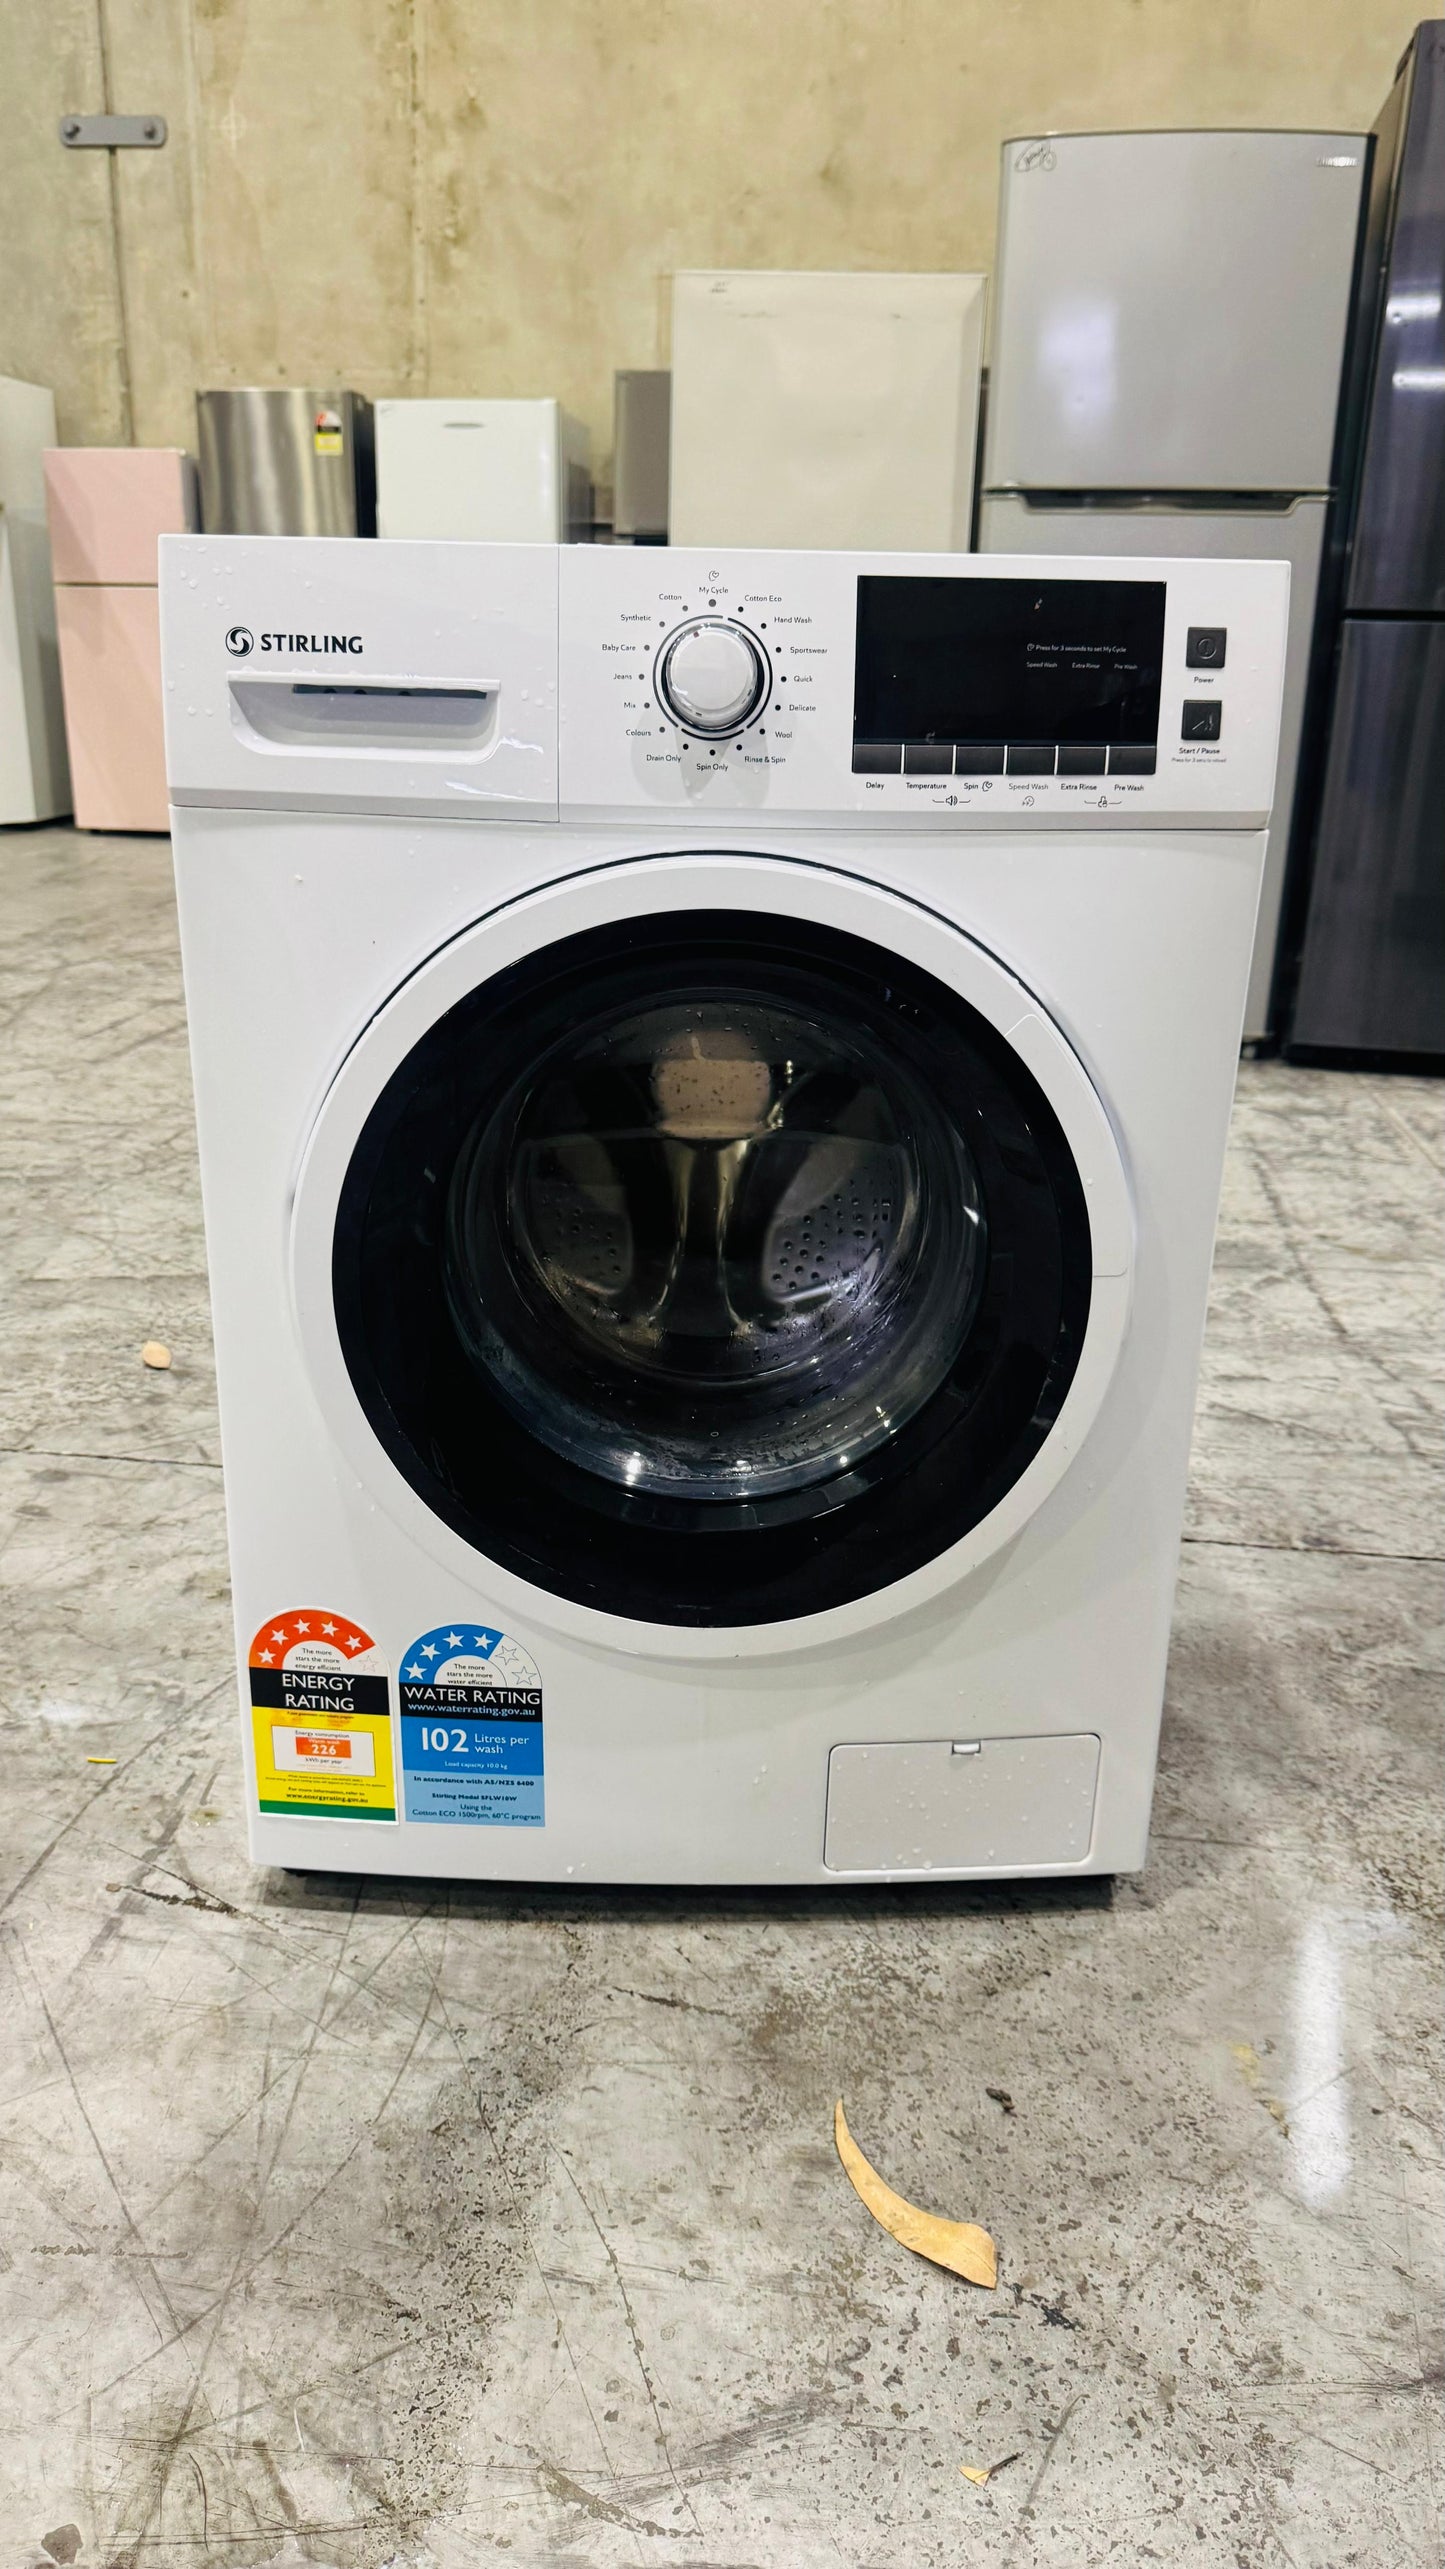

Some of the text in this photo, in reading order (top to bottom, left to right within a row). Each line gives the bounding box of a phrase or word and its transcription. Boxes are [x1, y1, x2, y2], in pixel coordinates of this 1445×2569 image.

[698, 586, 729, 595] My Cycle
[658, 593, 682, 601] Cotton
[744, 594, 768, 602] Cotton
[620, 614, 652, 622] Synthetic
[261, 634, 363, 654] STIRLING
[602, 643, 619, 653] Baby
[790, 646, 828, 655] Sportswear
[1035, 644, 1051, 652] Press
[1111, 646, 1127, 654] Cycle
[789, 704, 816, 712] Delicate
[646, 754, 682, 763] Drain Only
[744, 755, 763, 763] Rinse
[771, 756, 786, 764] Spin
[696, 763, 728, 772] Spin Only
[865, 781, 884, 790] Delay
[906, 782, 947, 790] Temperature
[964, 782, 979, 791] Spin
[1008, 783, 1030, 791] Speed
[281, 1673, 355, 1691] ENERGY
[404, 1686, 540, 1705] WATER RATING
[285, 1693, 355, 1711] RATING
[407, 1702, 535, 1717] www.waterrating.gov.au
[422, 1727, 469, 1753] 102
[474, 1733, 529, 1747] Litres per
[312, 1743, 337, 1755] 226
[474, 1745, 504, 1754] wash
[286, 1793, 369, 1803] www.energyrating.gov.au
[431, 1792, 456, 1800] Stirling
[460, 1803, 479, 1811] Using
[439, 1809, 456, 1817] ECO
